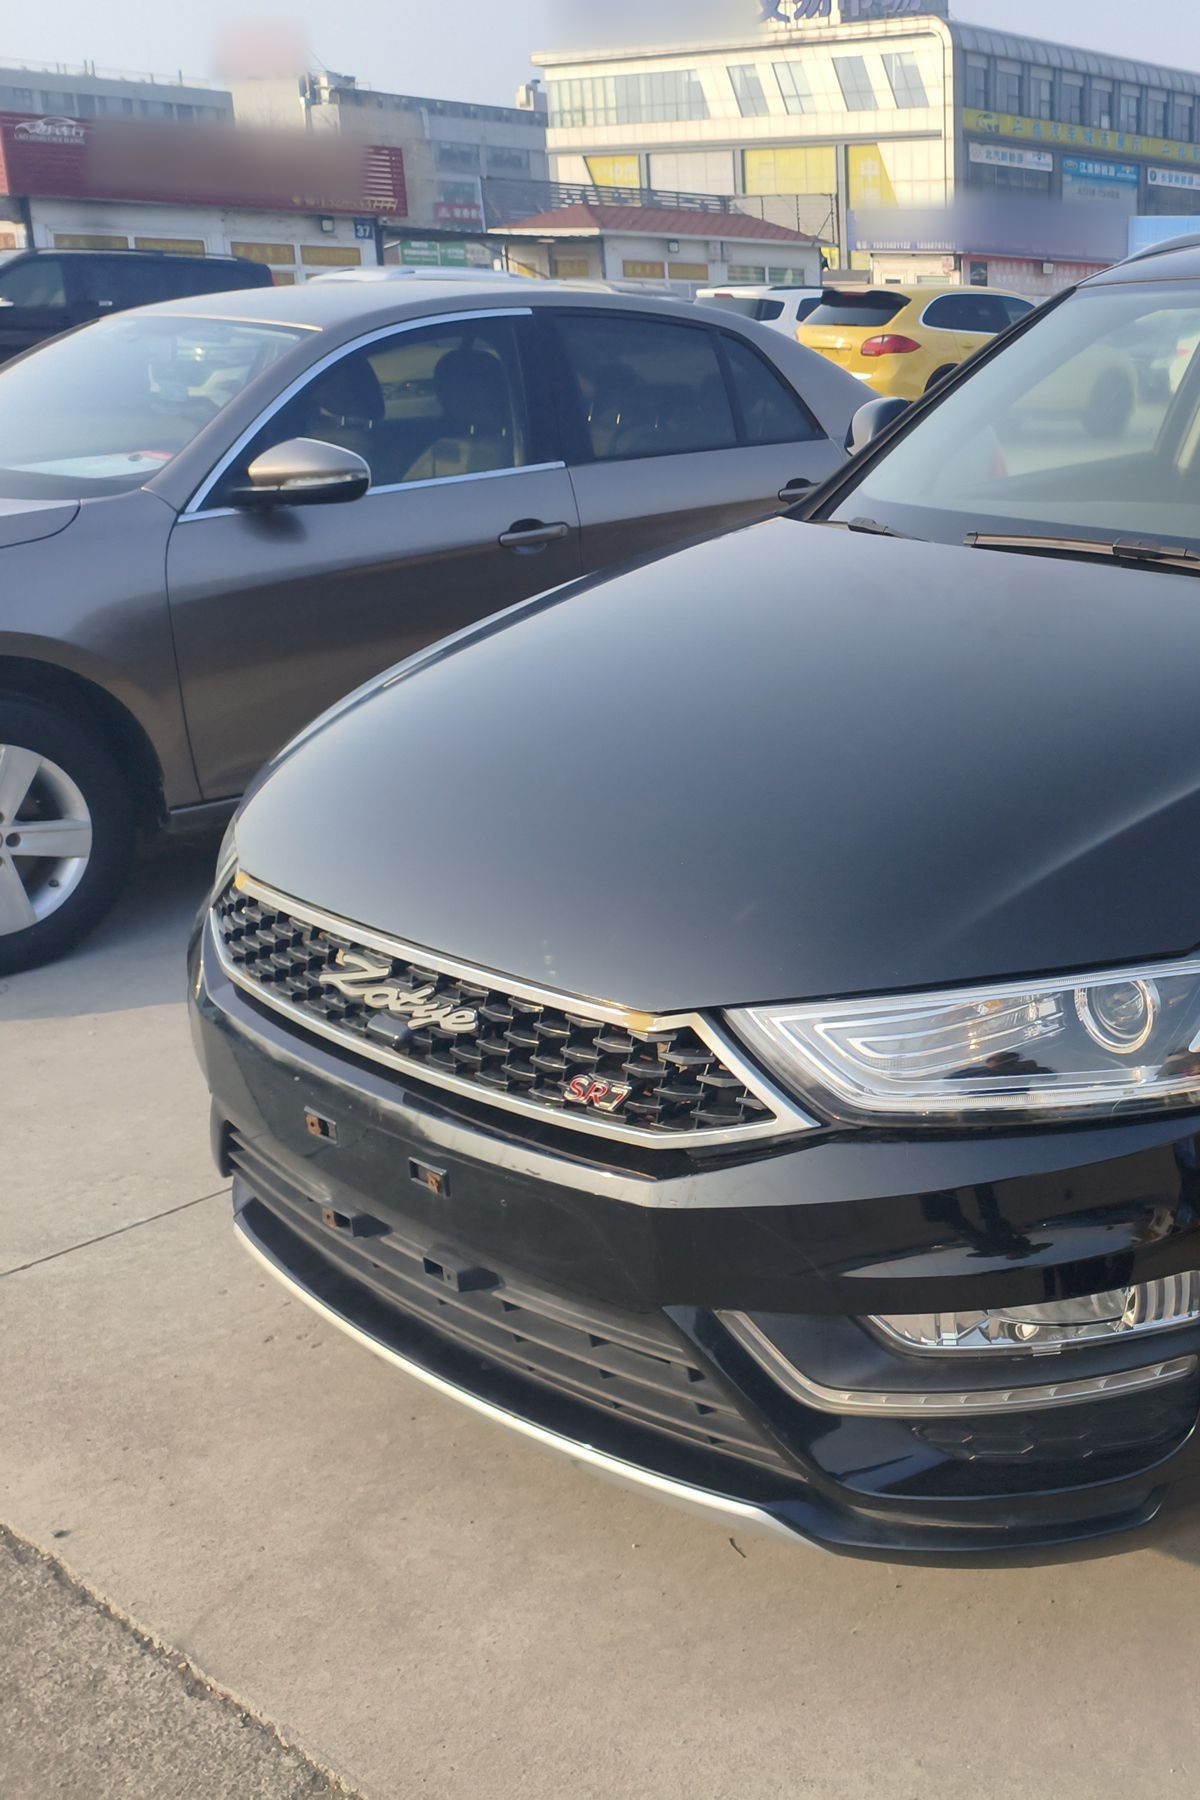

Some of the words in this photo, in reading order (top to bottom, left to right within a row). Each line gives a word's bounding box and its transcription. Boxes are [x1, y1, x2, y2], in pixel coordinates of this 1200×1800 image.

[356, 225, 371, 237] 37
[319, 953, 479, 1034] Zotye
[563, 1074, 632, 1112] SR7
